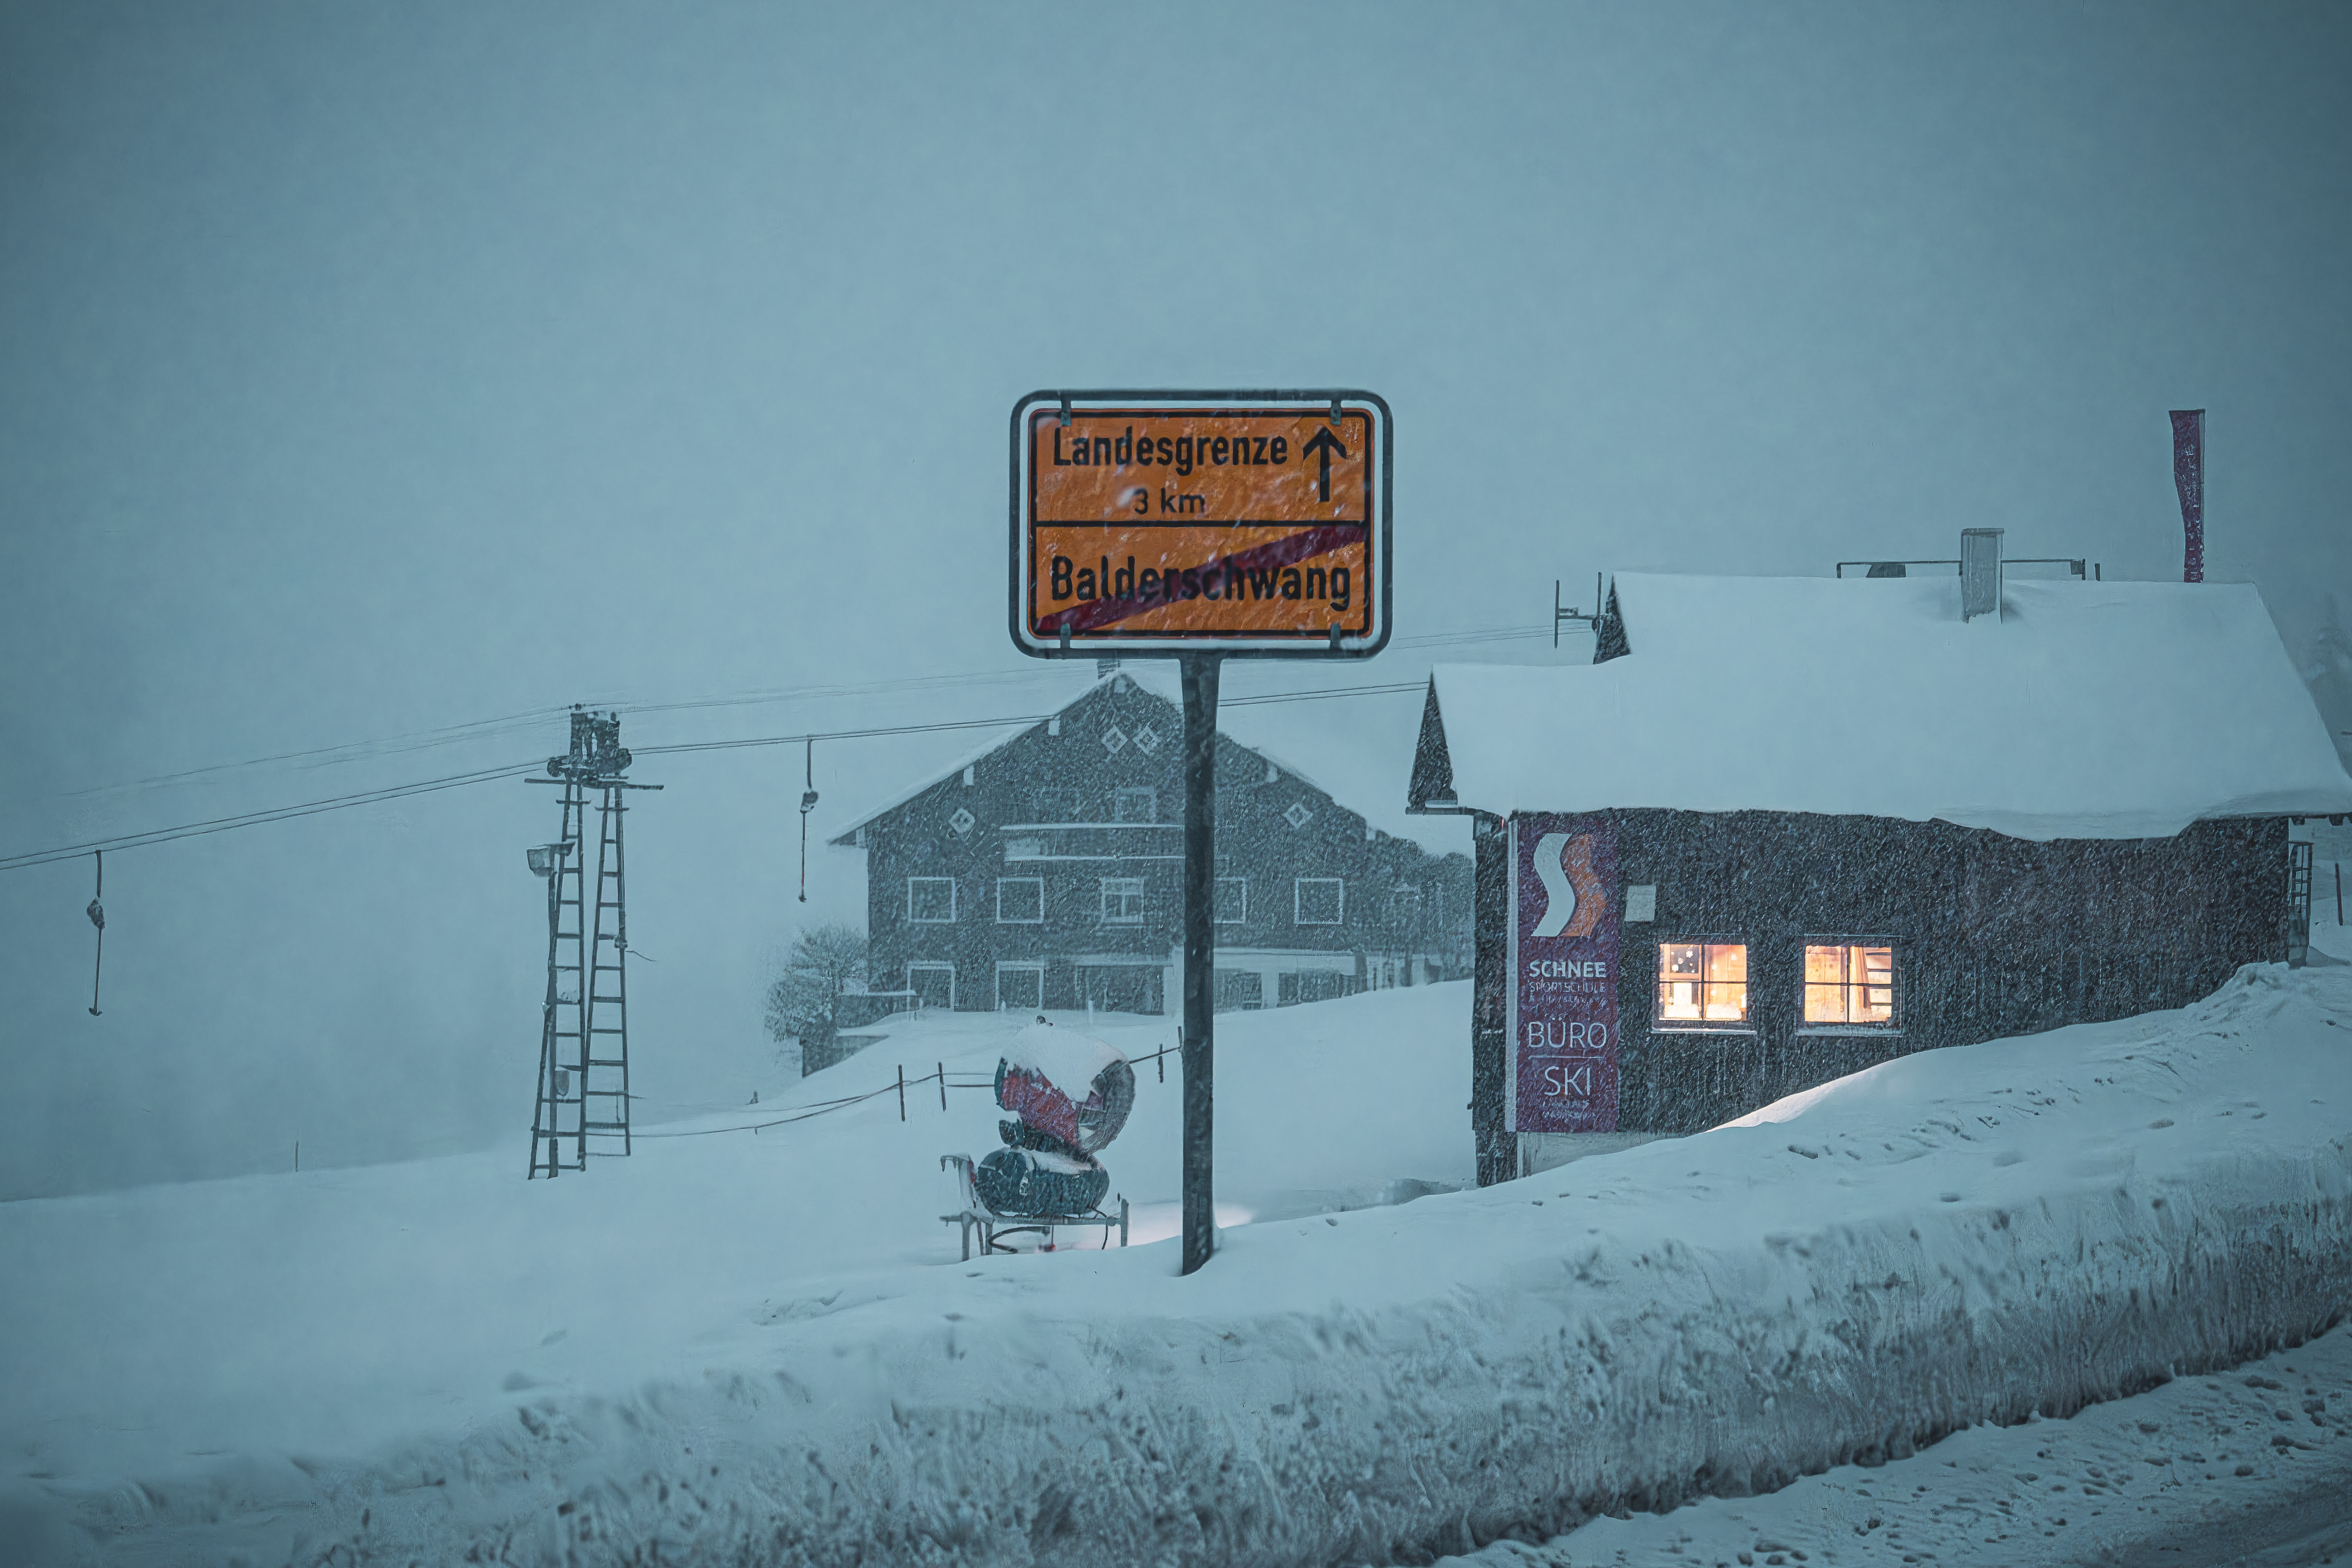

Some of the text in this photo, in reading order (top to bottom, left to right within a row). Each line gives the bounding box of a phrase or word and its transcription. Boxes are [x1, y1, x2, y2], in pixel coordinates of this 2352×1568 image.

[1053, 425, 1289, 476] Landesgrenze
[1133, 488, 1206, 515] 3 km
[1051, 555, 1351, 612] Balderschwang
[1529, 959, 1607, 978] SCHNEE
[1544, 1065, 1591, 1096] SKI
